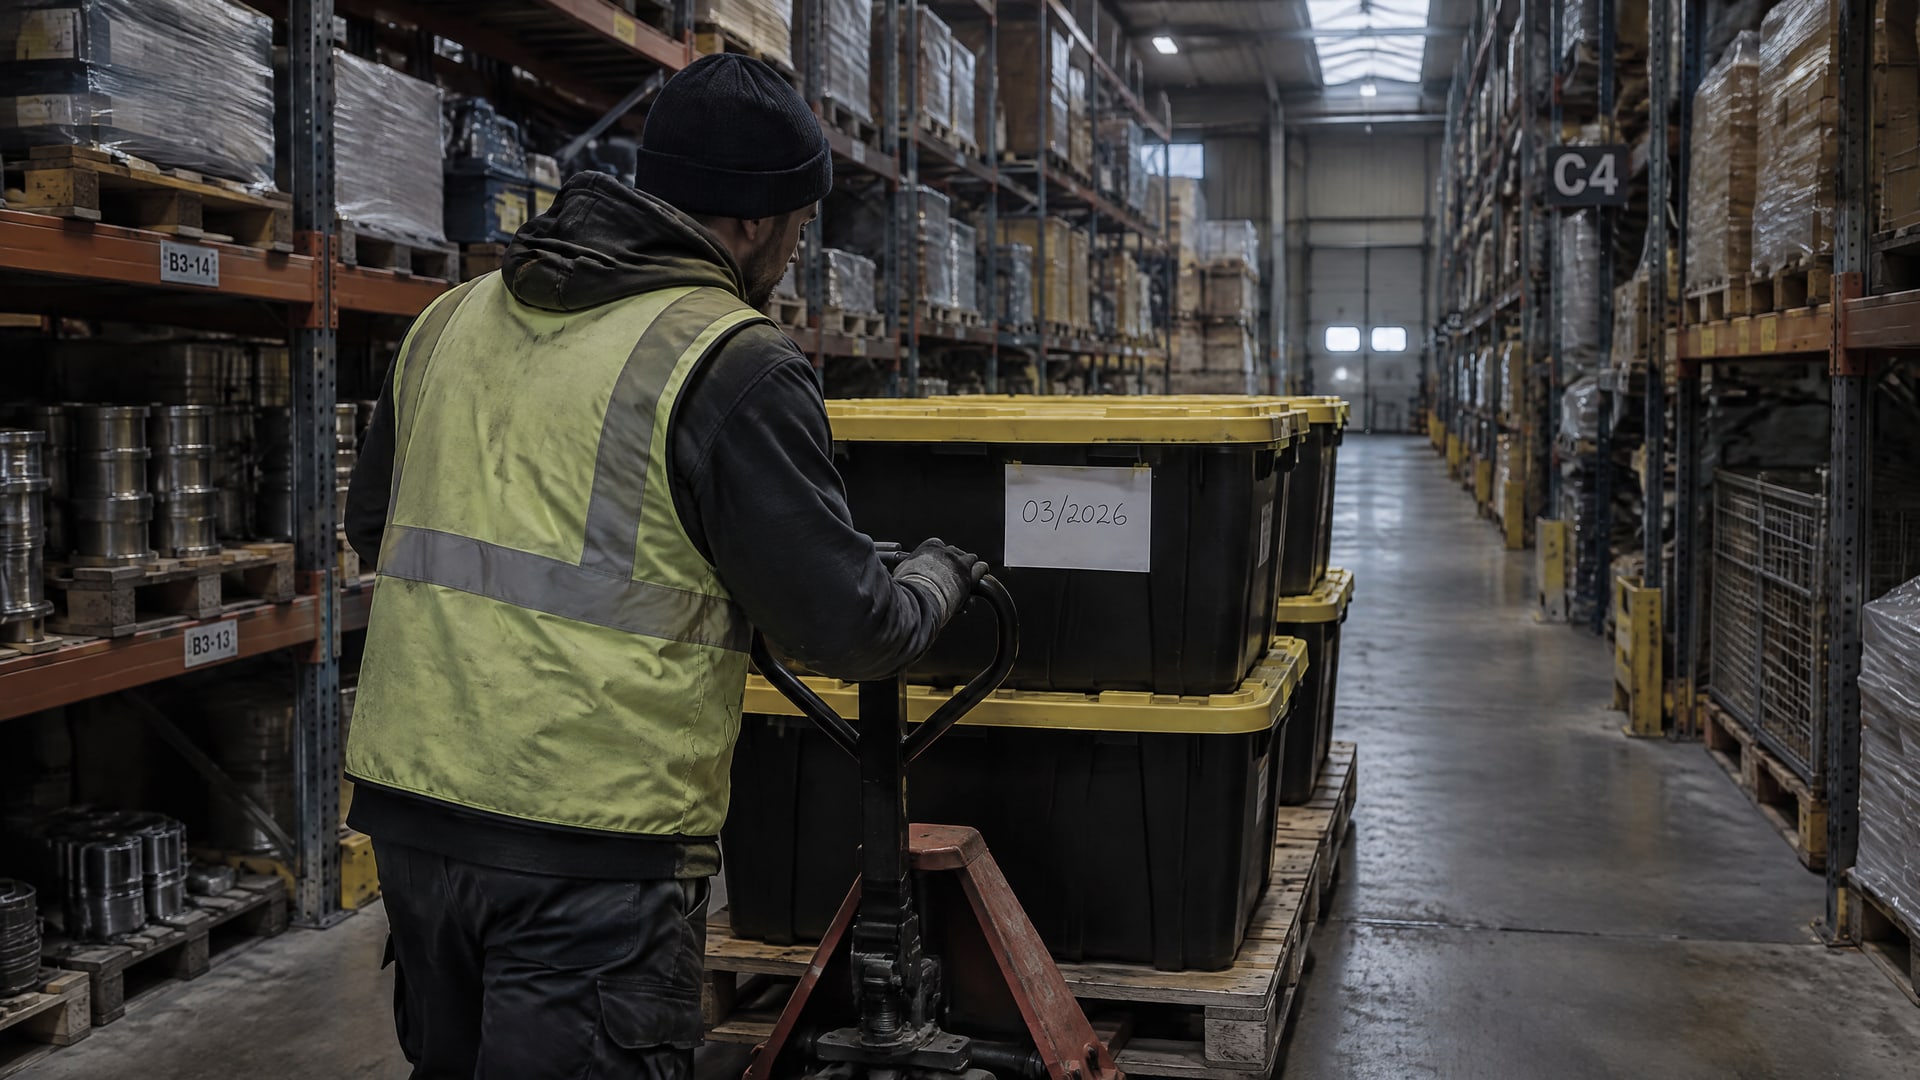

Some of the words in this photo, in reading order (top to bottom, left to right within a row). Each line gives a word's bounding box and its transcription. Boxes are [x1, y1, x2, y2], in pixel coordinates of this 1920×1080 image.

[1554, 152, 1618, 196] C4
[170, 252, 210, 276] B3-14
[1022, 494, 1128, 531] 03/2026
[193, 630, 230, 656] B3-13
